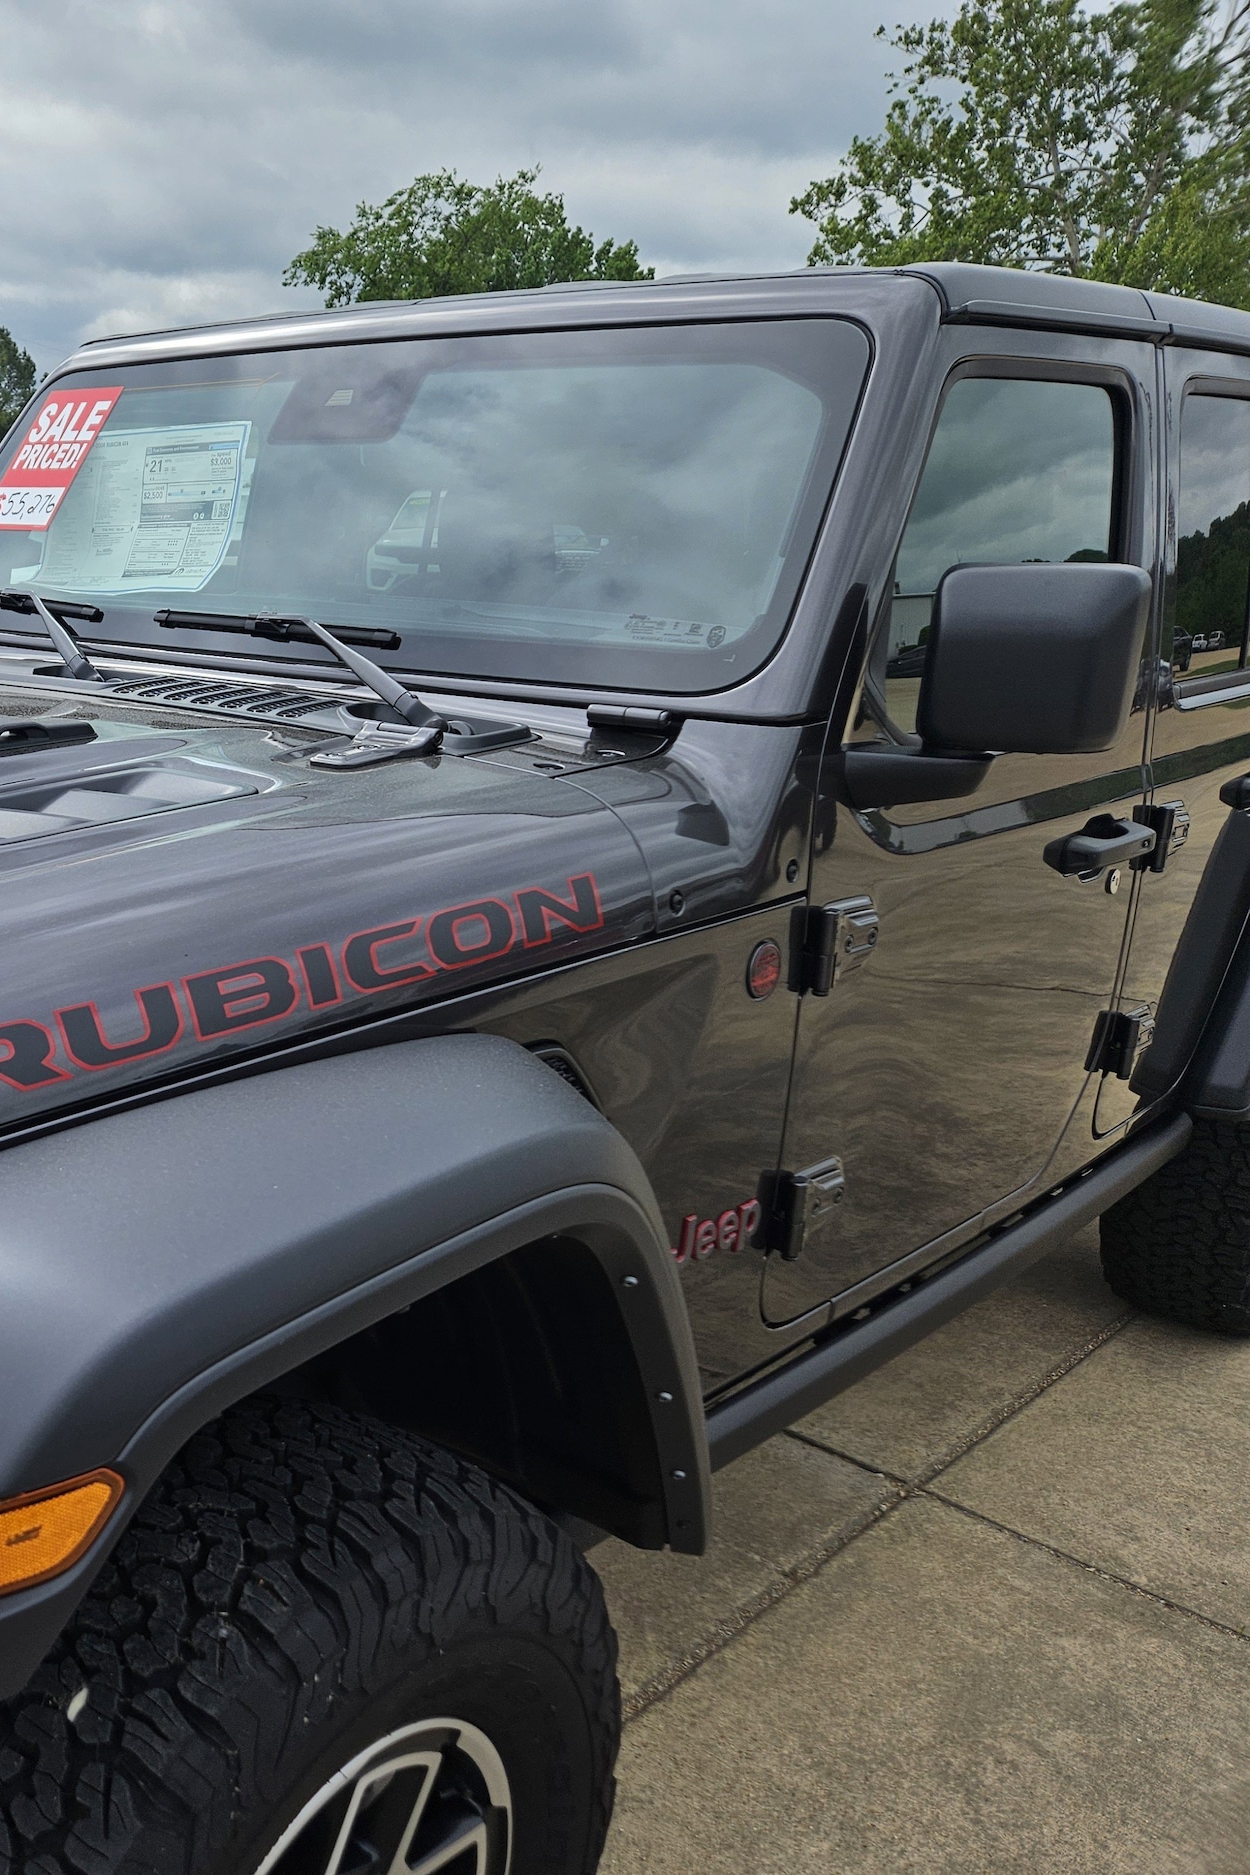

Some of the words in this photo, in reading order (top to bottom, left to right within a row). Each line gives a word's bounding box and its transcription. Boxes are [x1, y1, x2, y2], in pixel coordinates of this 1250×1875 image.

[28, 400, 113, 442] SALE
[12, 442, 88, 470] PRICED!
[149, 459, 162, 473] 21
[210, 457, 232, 467] $3,000
[670, 1197, 762, 1264] Jeep
